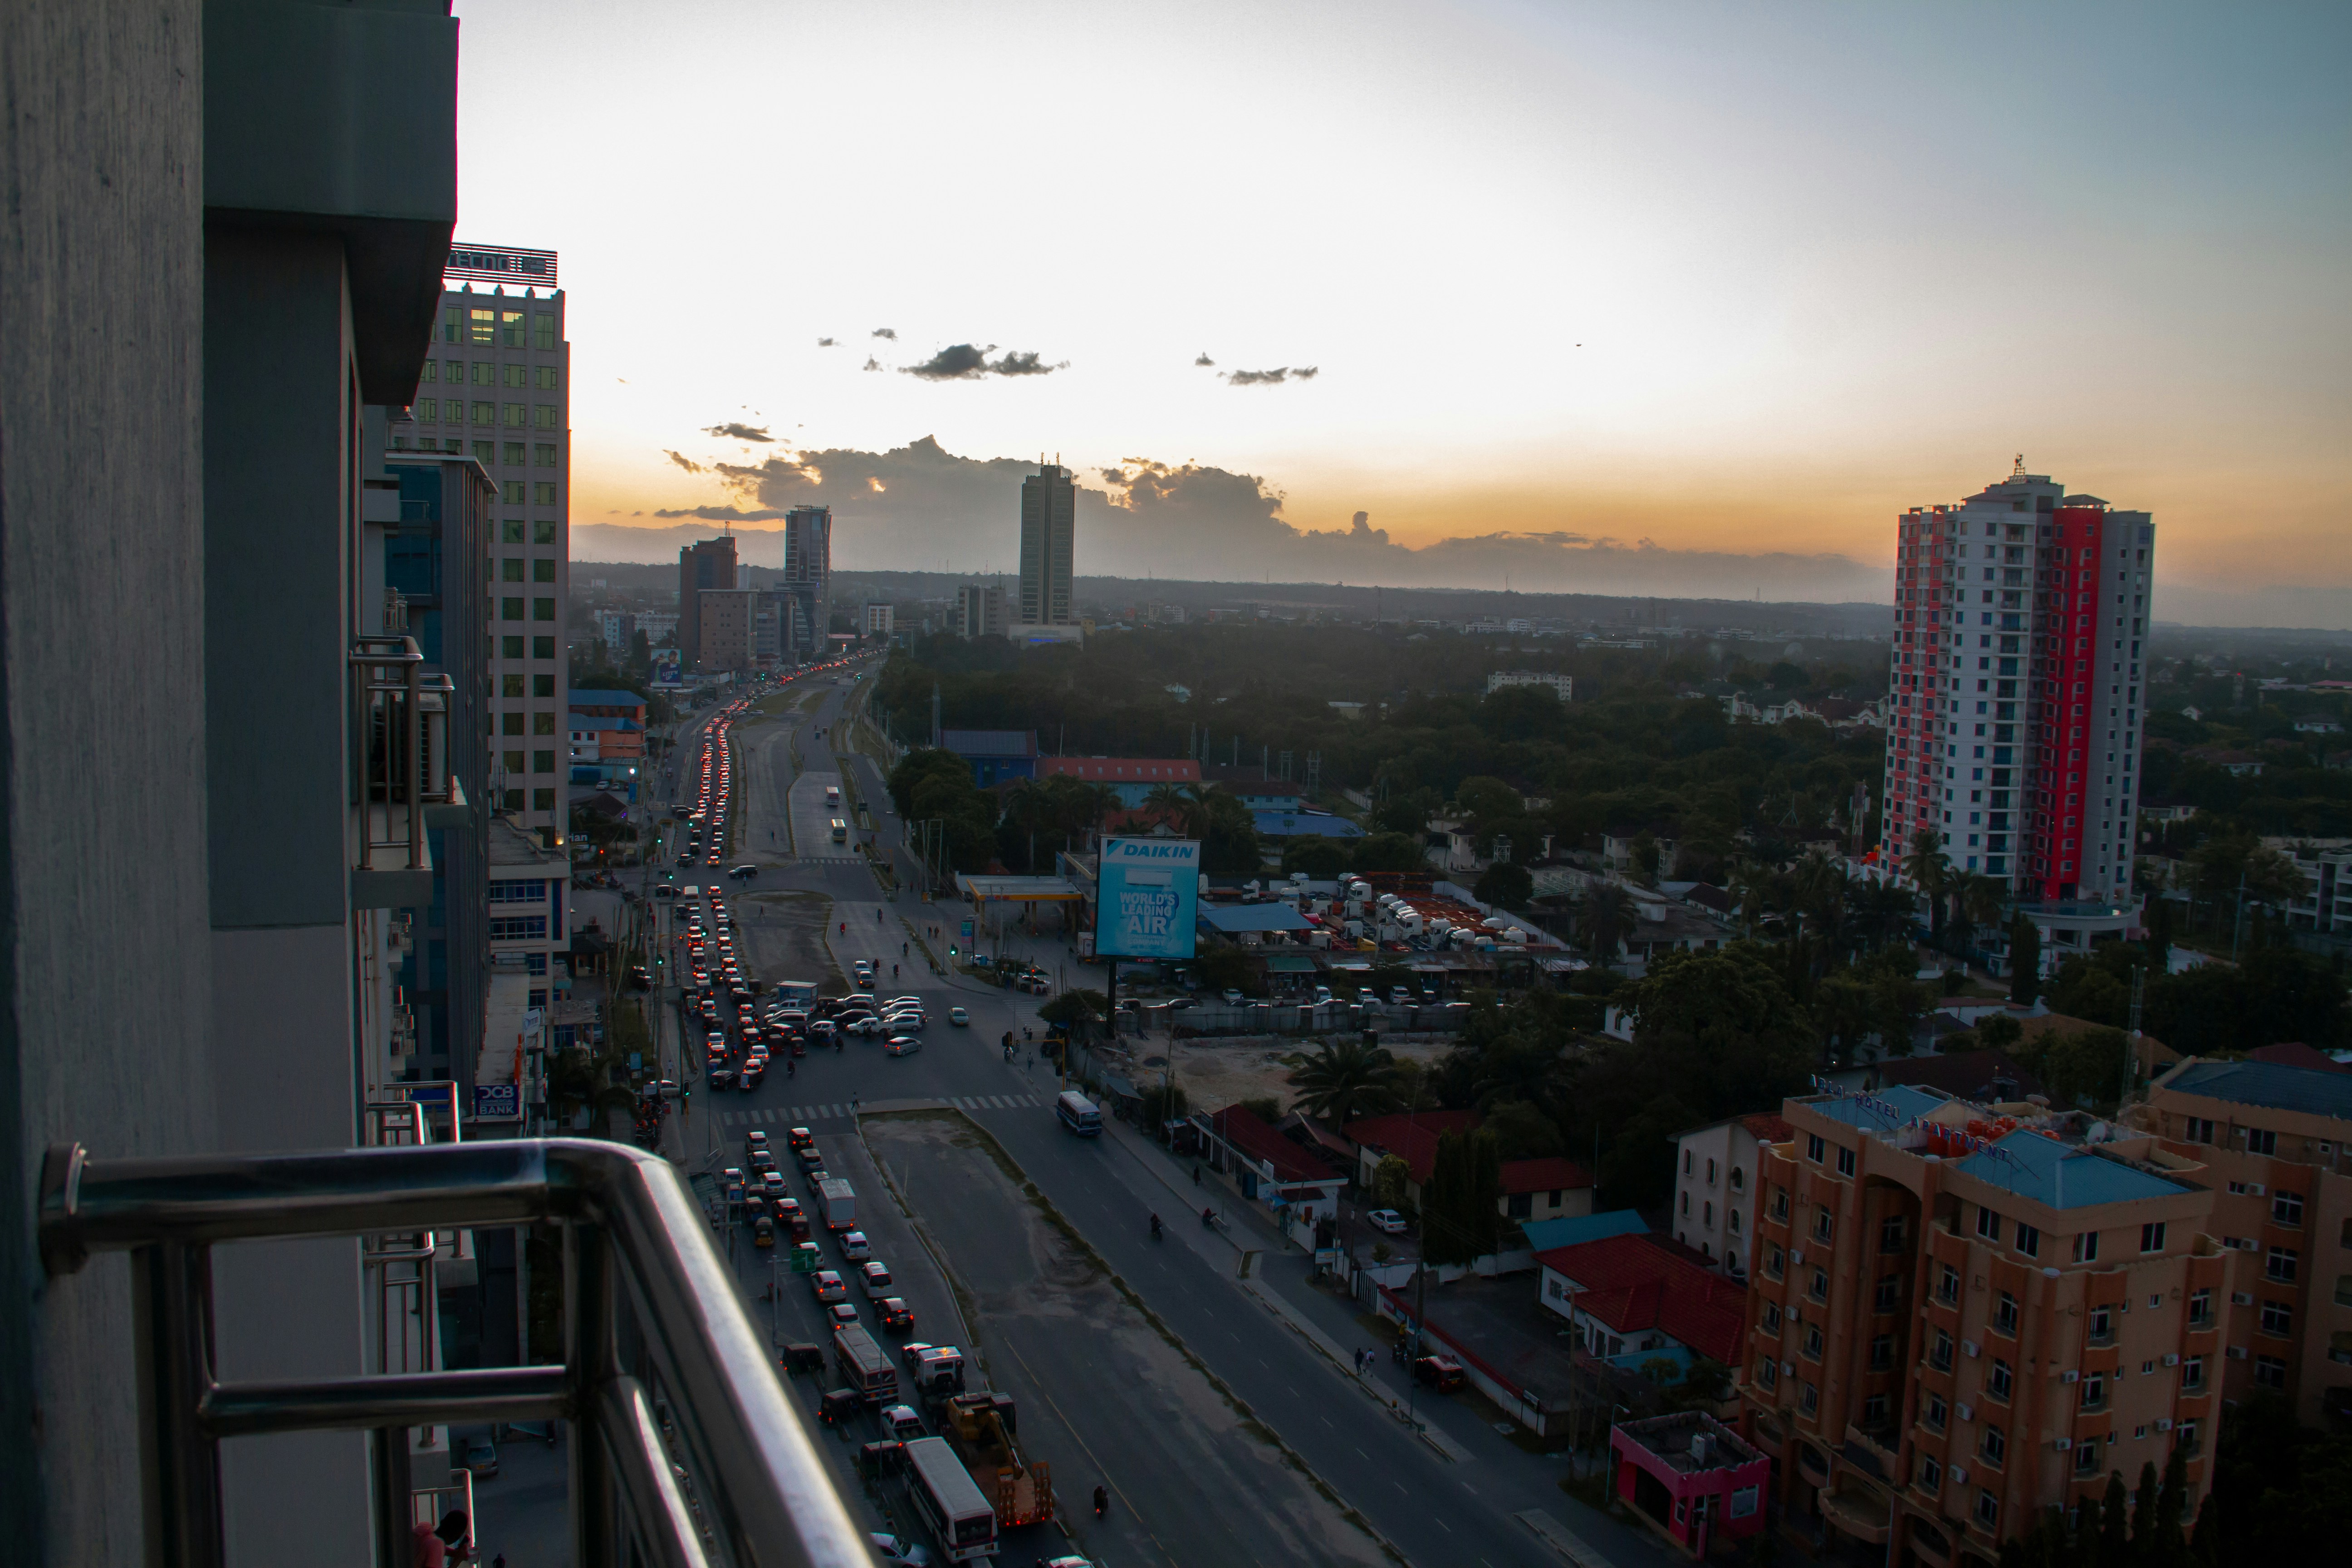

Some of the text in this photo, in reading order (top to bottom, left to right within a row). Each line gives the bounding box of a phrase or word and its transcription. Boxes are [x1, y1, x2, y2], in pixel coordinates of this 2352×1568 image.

[446, 253, 510, 271] TECNO
[1124, 844, 1194, 858] DAIKIN
[1120, 892, 1175, 906] WORLD'S
[1122, 905, 1172, 916] LEADING
[1127, 916, 1166, 935] AIR
[479, 1086, 514, 1098] DCB
[480, 1105, 514, 1115] BANK
[1808, 1074, 2009, 1161] ABLA HOTEL APARTMENT
